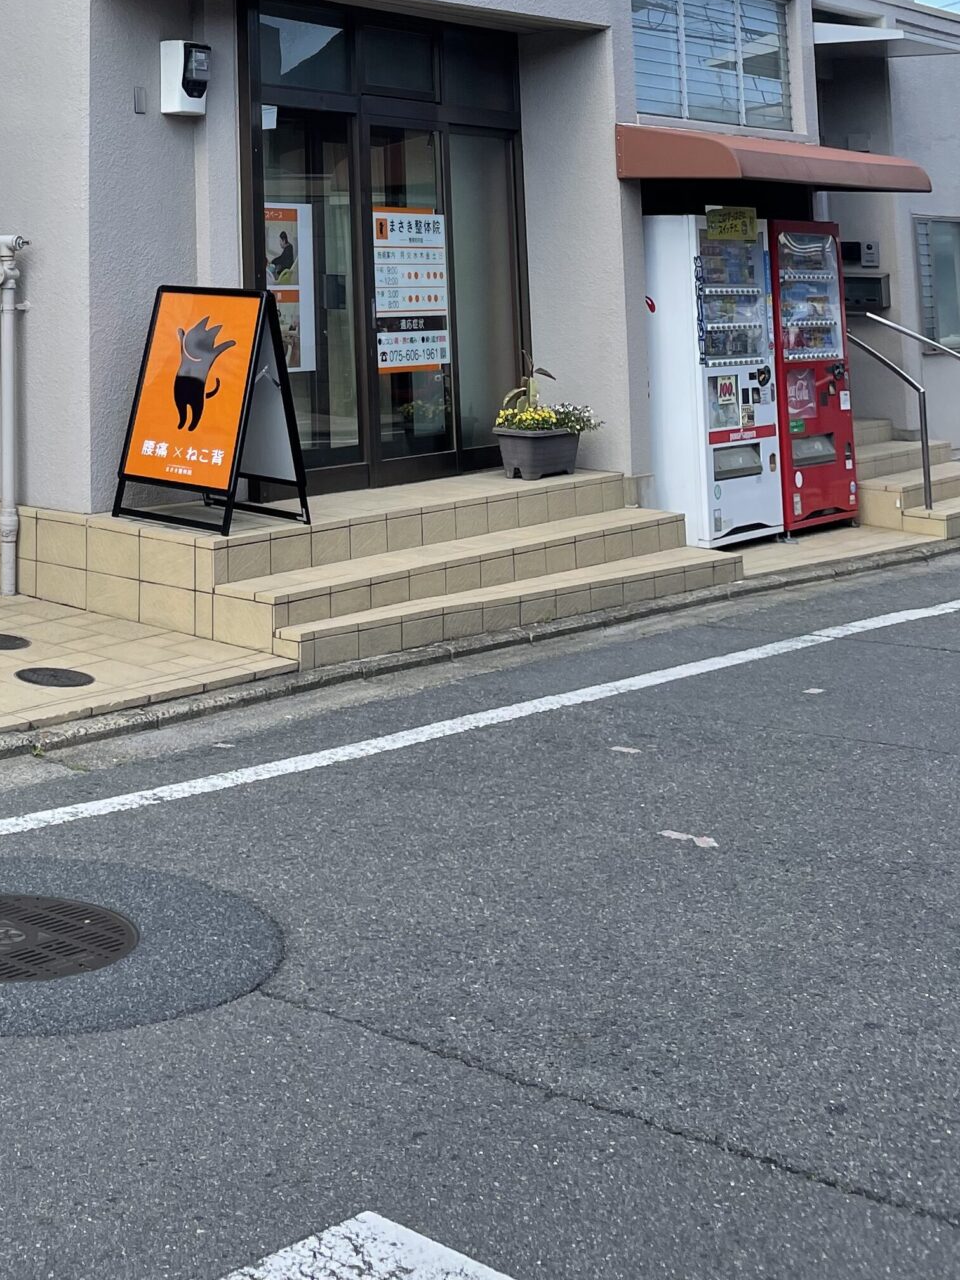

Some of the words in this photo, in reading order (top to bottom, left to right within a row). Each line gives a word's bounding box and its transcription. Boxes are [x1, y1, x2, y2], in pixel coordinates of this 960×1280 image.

[389, 219, 441, 235] まさき整体院
[389, 348, 438, 363] 075-606-1961
